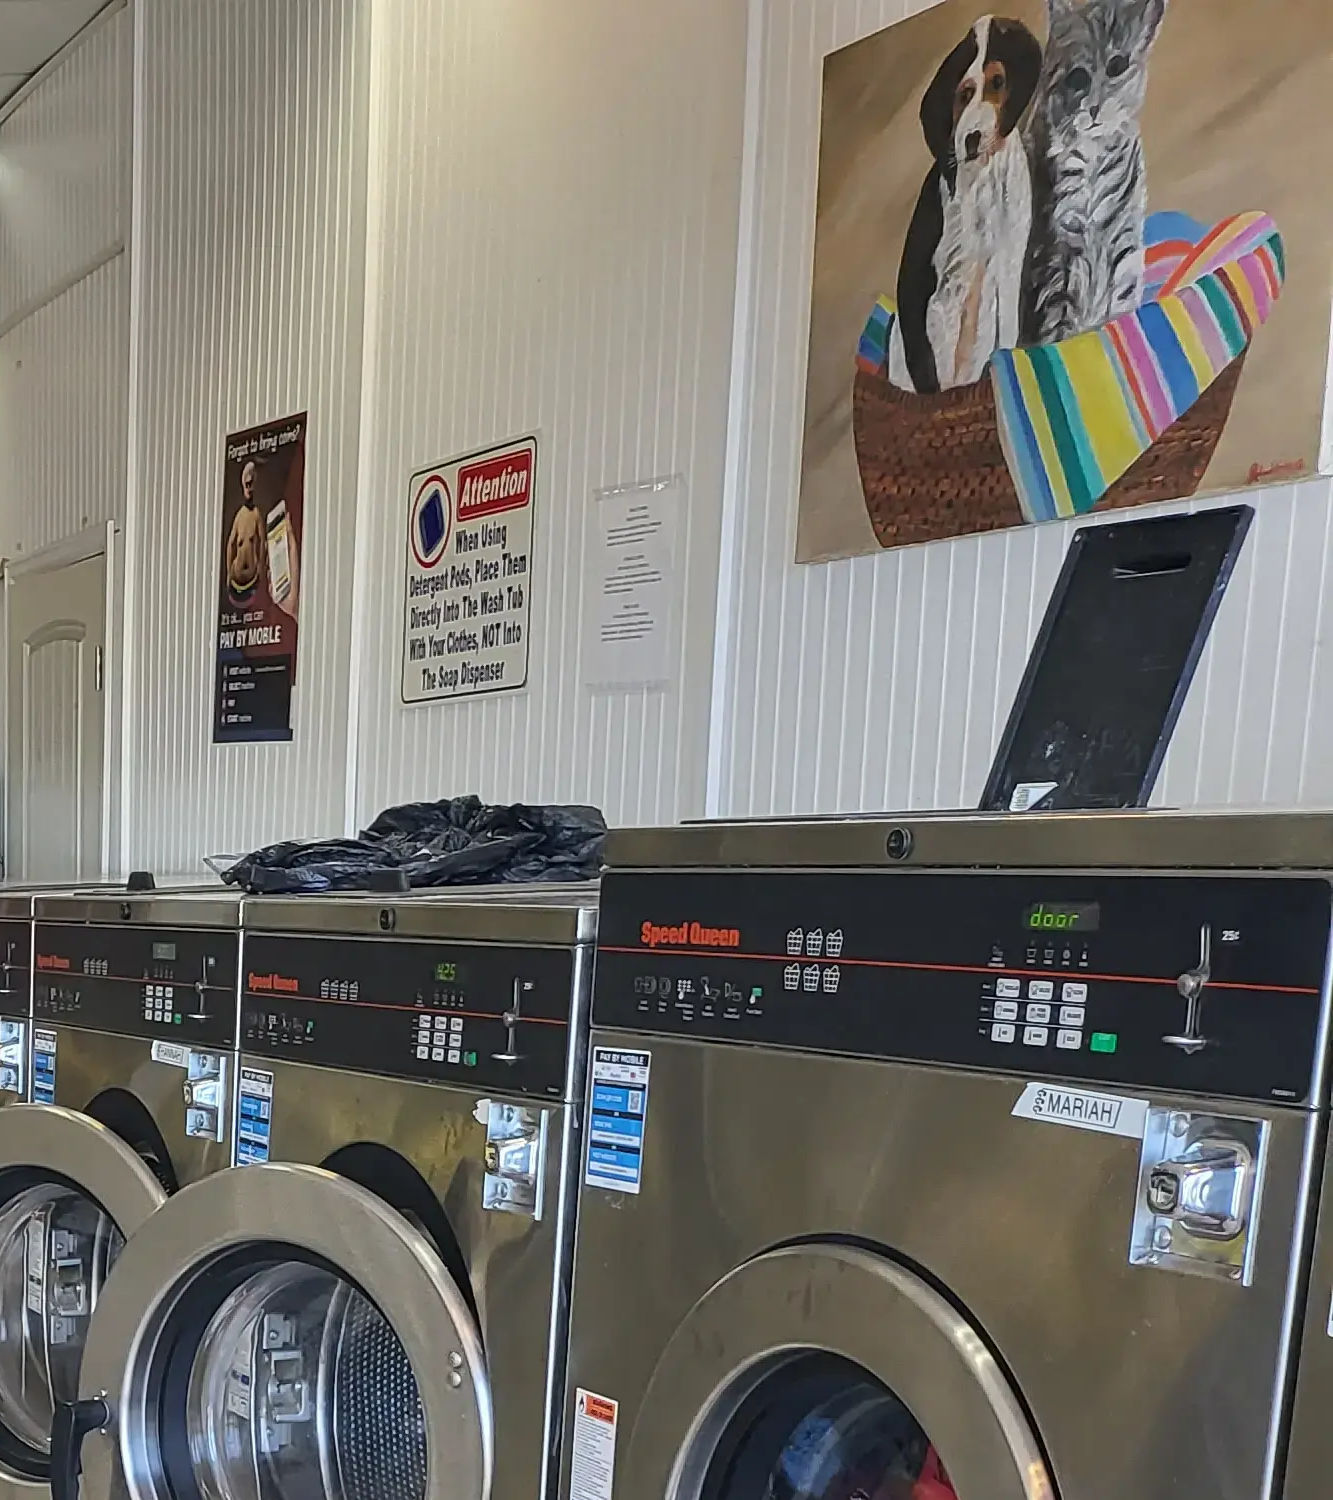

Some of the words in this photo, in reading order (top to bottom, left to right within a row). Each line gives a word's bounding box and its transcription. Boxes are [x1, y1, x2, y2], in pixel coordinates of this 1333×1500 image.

[228, 440, 249, 462] Forgot
[250, 438, 258, 453] to
[259, 432, 278, 452] bring
[278, 424, 300, 445] coins?
[460, 466, 527, 508] Attention
[455, 529, 479, 554] When
[481, 521, 507, 550] Using
[409, 567, 449, 600] Detergent
[450, 562, 472, 589] Pods,
[475, 557, 499, 583] Place
[501, 552, 527, 577] Them
[410, 602, 441, 631] Directly
[443, 599, 459, 623] Into
[462, 595, 478, 619] The
[480, 587, 504, 615] Wash
[507, 583, 524, 611] Tub
[219, 631, 235, 649] PAY
[236, 629, 248, 648] BY
[409, 636, 426, 661] With
[428, 634, 446, 658] Your
[446, 628, 479, 656] Clothes,
[481, 622, 501, 649] NOT
[503, 620, 522, 645] Into
[421, 667, 436, 691] The
[438, 665, 459, 691] Soap
[460, 660, 505, 689] Dispenser
[1030, 904, 1080, 928] door
[641, 921, 688, 947] Speed
[689, 922, 740, 947] Queen
[1221, 930, 1240, 941] 25¢
[248, 972, 273, 992] Speed
[272, 974, 299, 992] Queen
[599, 1052, 612, 1061] PAY
[611, 1053, 621, 1063] BY
[620, 1053, 645, 1065] MOBILE
[1047, 1093, 1113, 1123] MARIAH
